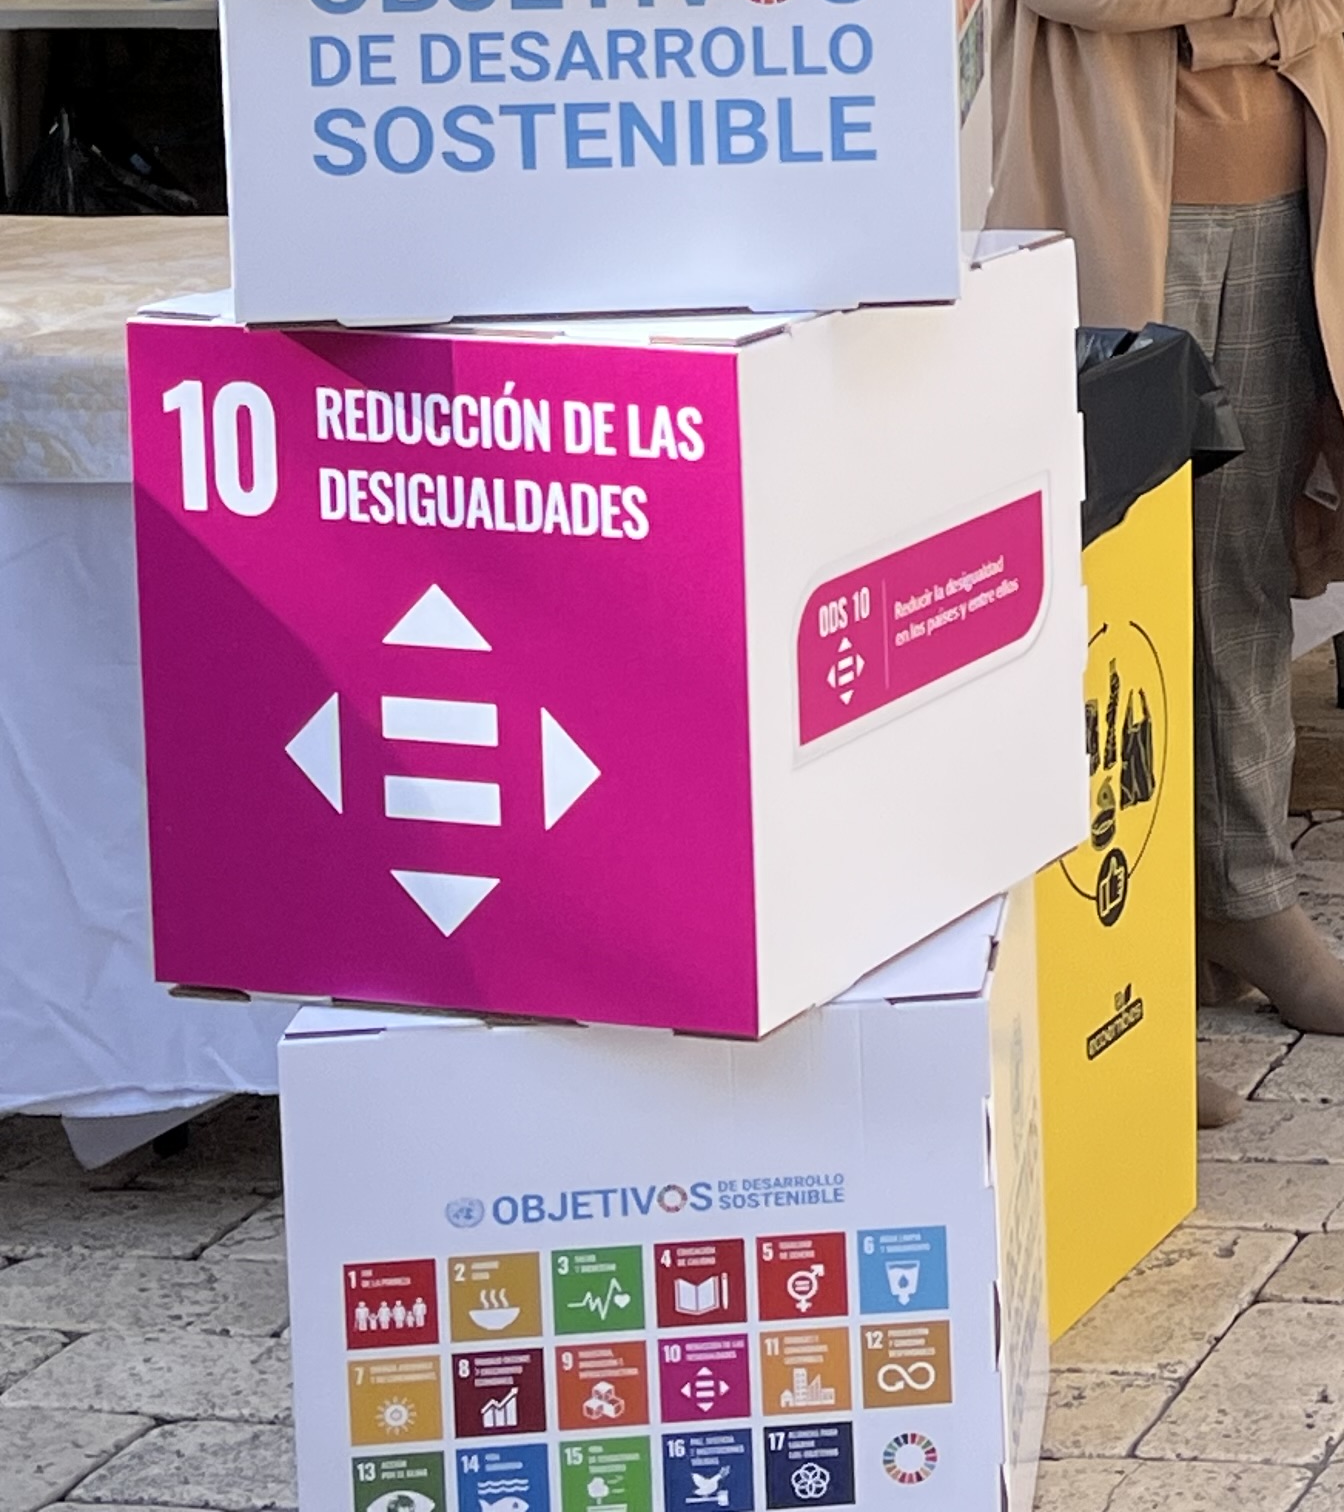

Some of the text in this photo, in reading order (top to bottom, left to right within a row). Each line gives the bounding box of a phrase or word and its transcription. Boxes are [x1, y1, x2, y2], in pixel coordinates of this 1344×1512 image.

[309, 23, 873, 86] DE DESARROLLO
[313, 95, 877, 176] SOSTENIBLE
[316, 381, 705, 462] REDUCCIÓN DE LAS
[162, 380, 278, 517] 10
[319, 467, 650, 540] DESIGUALDADES
[894, 555, 1004, 620] Reducir la desigualdad
[818, 586, 870, 638] ODS 10
[895, 629, 910, 646] en
[909, 621, 925, 640] los
[968, 589, 995, 612] entre
[995, 578, 1020, 599] ellos
[718, 1173, 844, 1192] DE DESARROLLO
[492, 1181, 712, 1225] OBJETIVOS
[719, 1187, 845, 1210] SOSTENIBLE
[762, 1242, 774, 1261] 5
[863, 1236, 875, 1255] 6
[557, 1256, 570, 1275] 3
[660, 1249, 672, 1268] 4
[347, 1270, 357, 1289] 1
[454, 1263, 466, 1282] 2
[763, 1337, 780, 1356] 11
[865, 1330, 884, 1349] 12
[561, 1351, 574, 1371] 9
[662, 1344, 682, 1363] 10
[354, 1366, 365, 1385] 7
[458, 1359, 471, 1378] 8
[667, 1439, 686, 1458] 16
[768, 1432, 786, 1452] 17
[460, 1454, 480, 1474] 14
[564, 1446, 583, 1466] 15
[356, 1461, 377, 1482] 13
